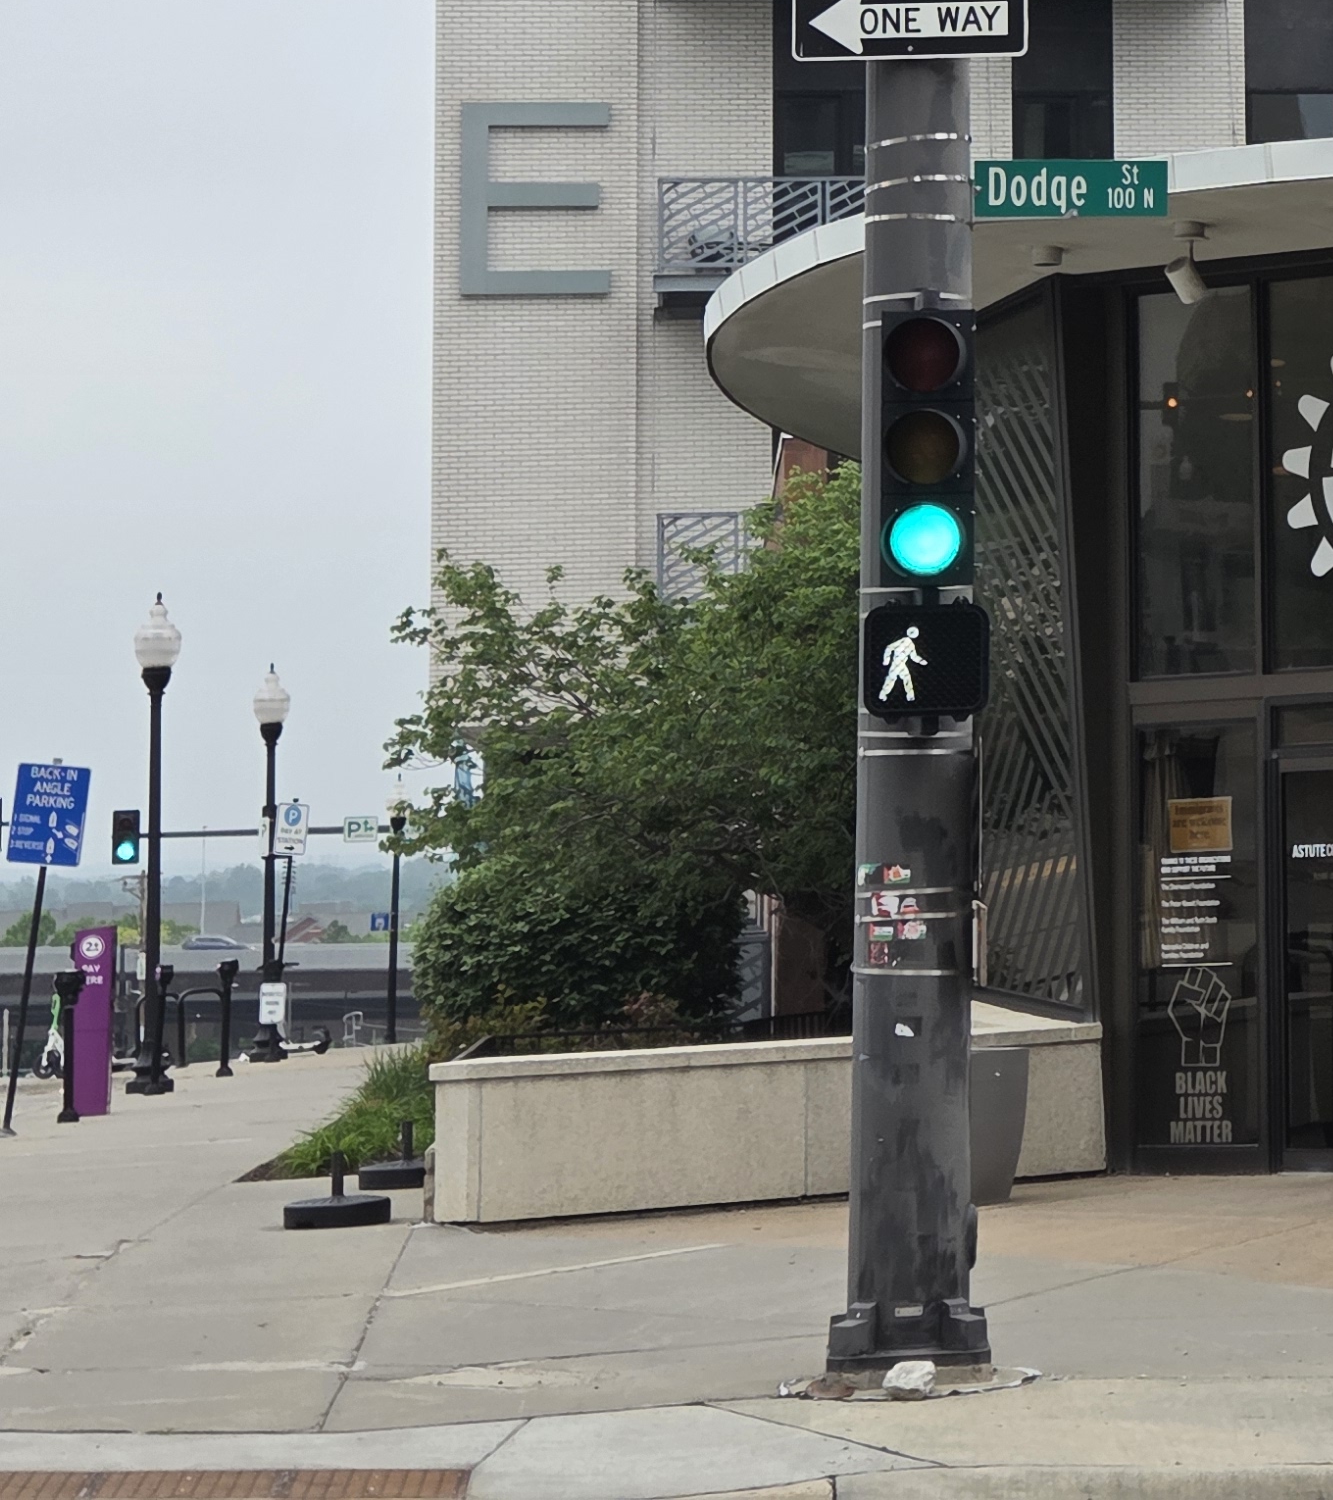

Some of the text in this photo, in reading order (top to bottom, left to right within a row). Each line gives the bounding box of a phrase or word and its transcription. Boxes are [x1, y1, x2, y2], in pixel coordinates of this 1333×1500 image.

[860, 5, 1001, 35] ONE WAY
[1121, 163, 1139, 185] St
[988, 166, 1087, 214] Dodge
[1107, 187, 1154, 209] 100 N
[31, 766, 78, 781] BACK-IN
[33, 781, 72, 795] ANGLE
[26, 794, 75, 809] PARKING
[347, 821, 362, 839] P
[1292, 843, 1326, 858] ASTUTE
[1175, 1070, 1227, 1094] BLACK
[1179, 1095, 1223, 1119] LIVES
[1170, 1120, 1233, 1144] MATTER
